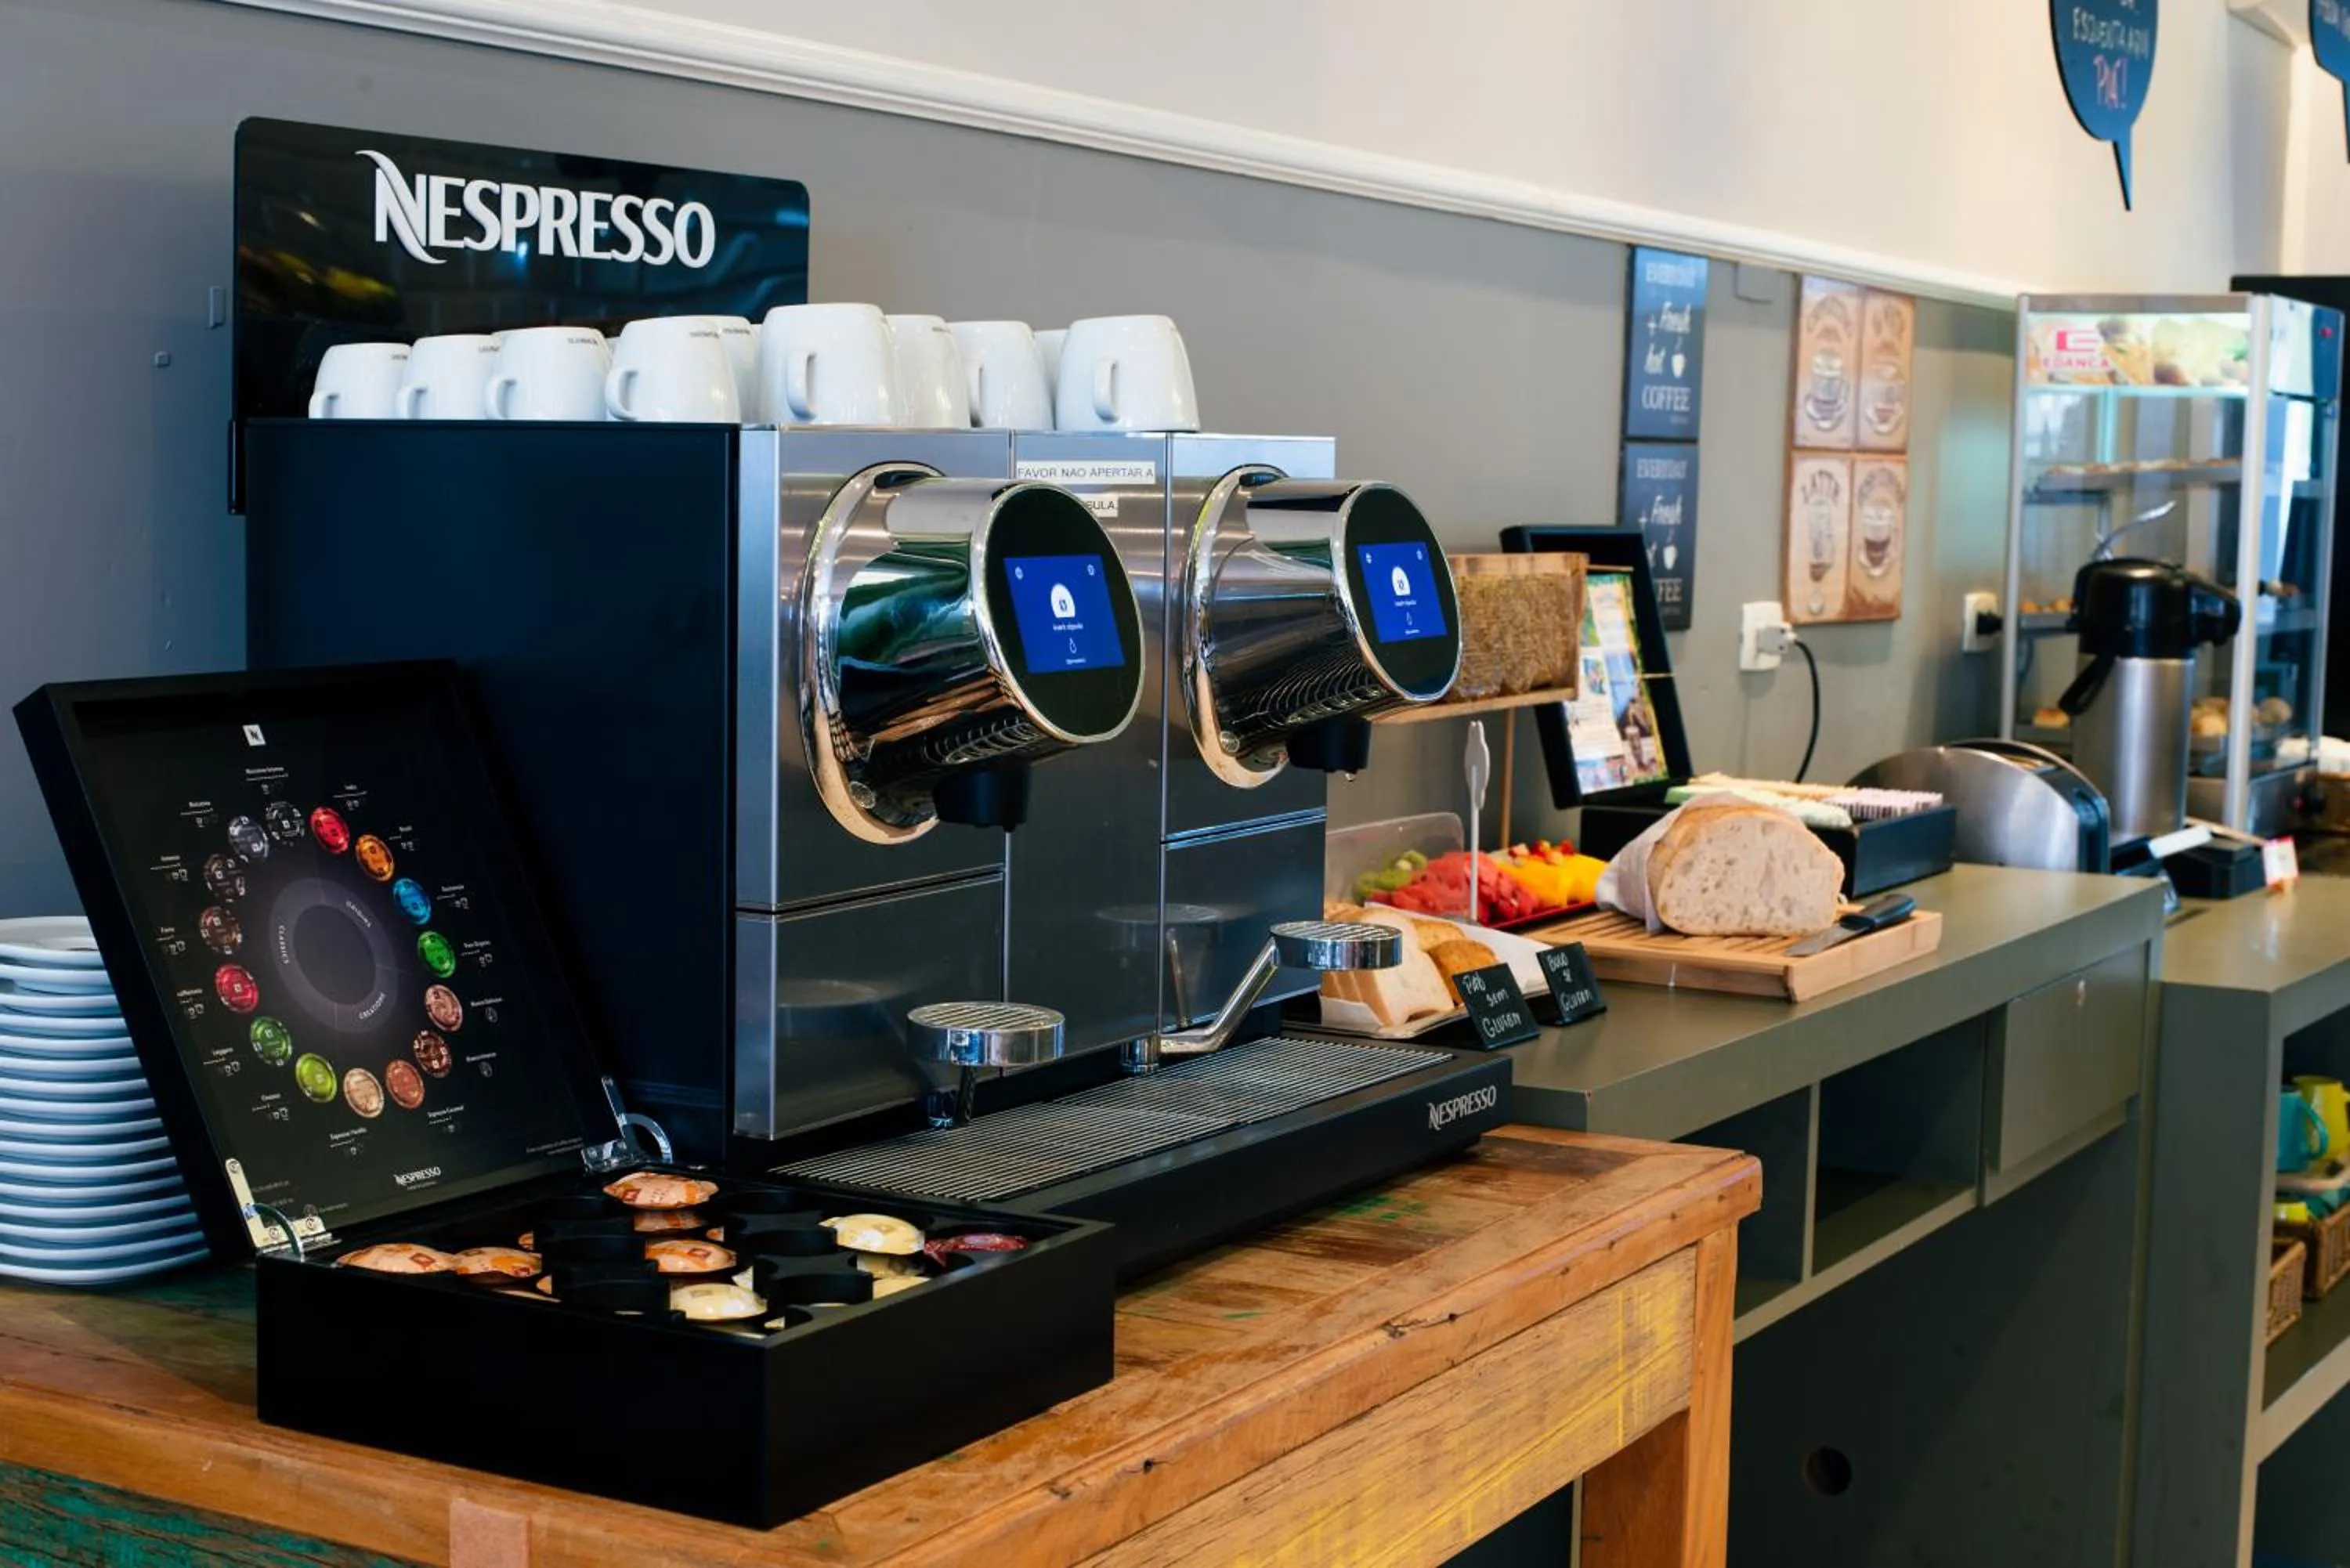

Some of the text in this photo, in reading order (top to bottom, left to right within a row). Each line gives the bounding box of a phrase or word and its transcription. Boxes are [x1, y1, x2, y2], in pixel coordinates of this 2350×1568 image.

[355, 150, 716, 269] NESPRESSO
[1642, 385, 1690, 412] COFFEE
[1018, 467, 1058, 478] FAVOR
[1090, 466, 1143, 477] APERTAR
[1145, 468, 1154, 477] A
[1427, 1085, 1497, 1131] NESPRESSO
[393, 1166, 441, 1187] NESPRESSO
